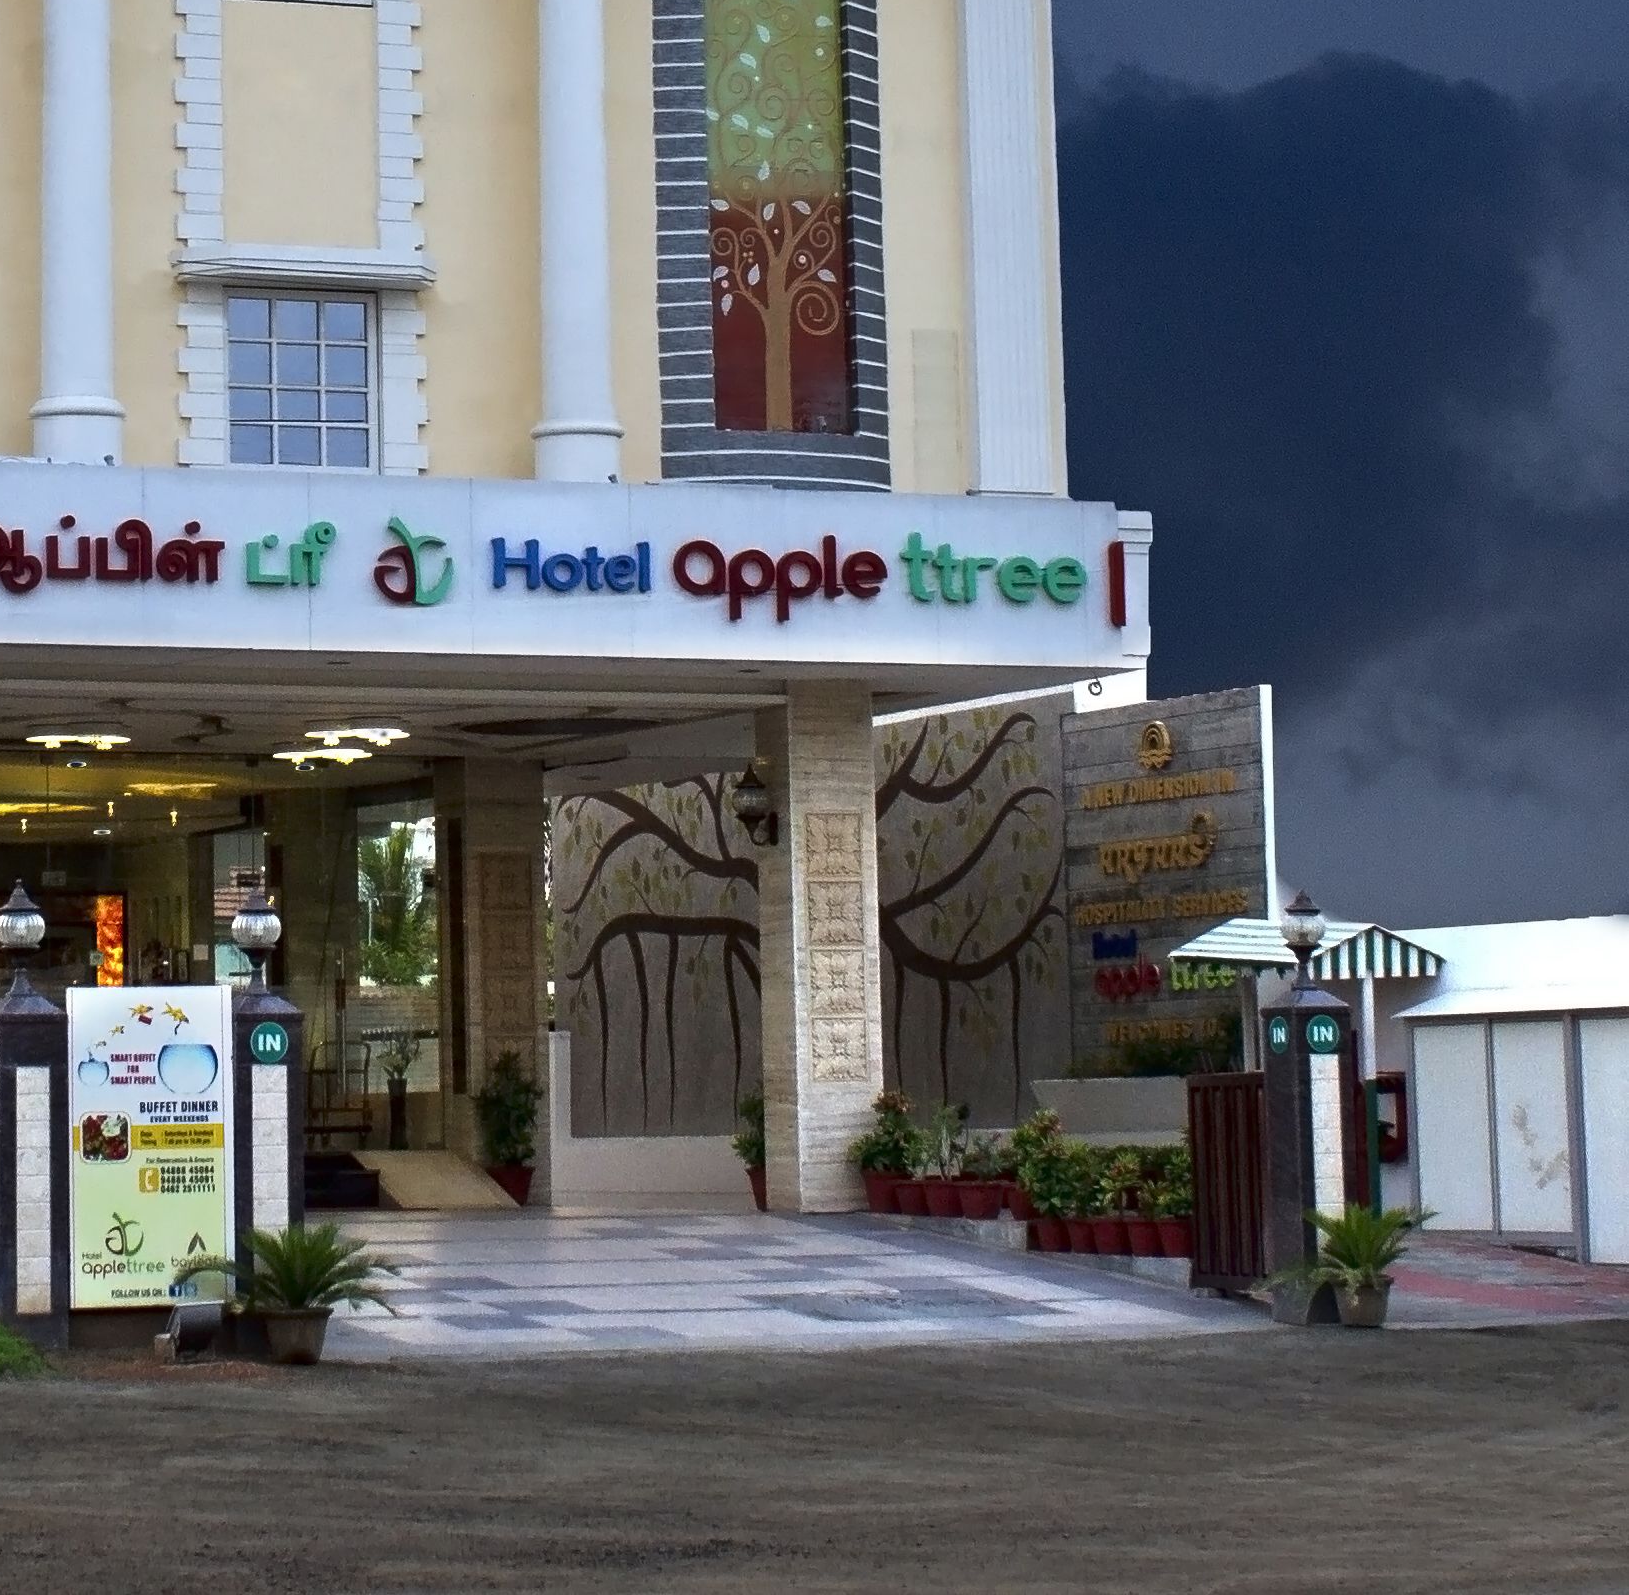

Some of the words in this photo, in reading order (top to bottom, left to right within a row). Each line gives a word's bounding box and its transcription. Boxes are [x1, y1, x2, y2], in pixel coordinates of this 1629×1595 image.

[490, 536, 652, 593] Hotel
[899, 530, 1088, 604] ttree
[1272, 1027, 1286, 1044] IN
[1313, 1025, 1333, 1043] IN
[258, 1033, 281, 1051] IN
[110, 1053, 132, 1063] SMART
[110, 1075, 132, 1085] SMART
[139, 1101, 178, 1114] BUFFET
[181, 1100, 218, 1113] DINNER
[149, 1115, 171, 1123] EVERY
[173, 1114, 209, 1123] WEEKENDS
[111, 1288, 139, 1299] FOLLOW
[140, 1288, 151, 1298] US
